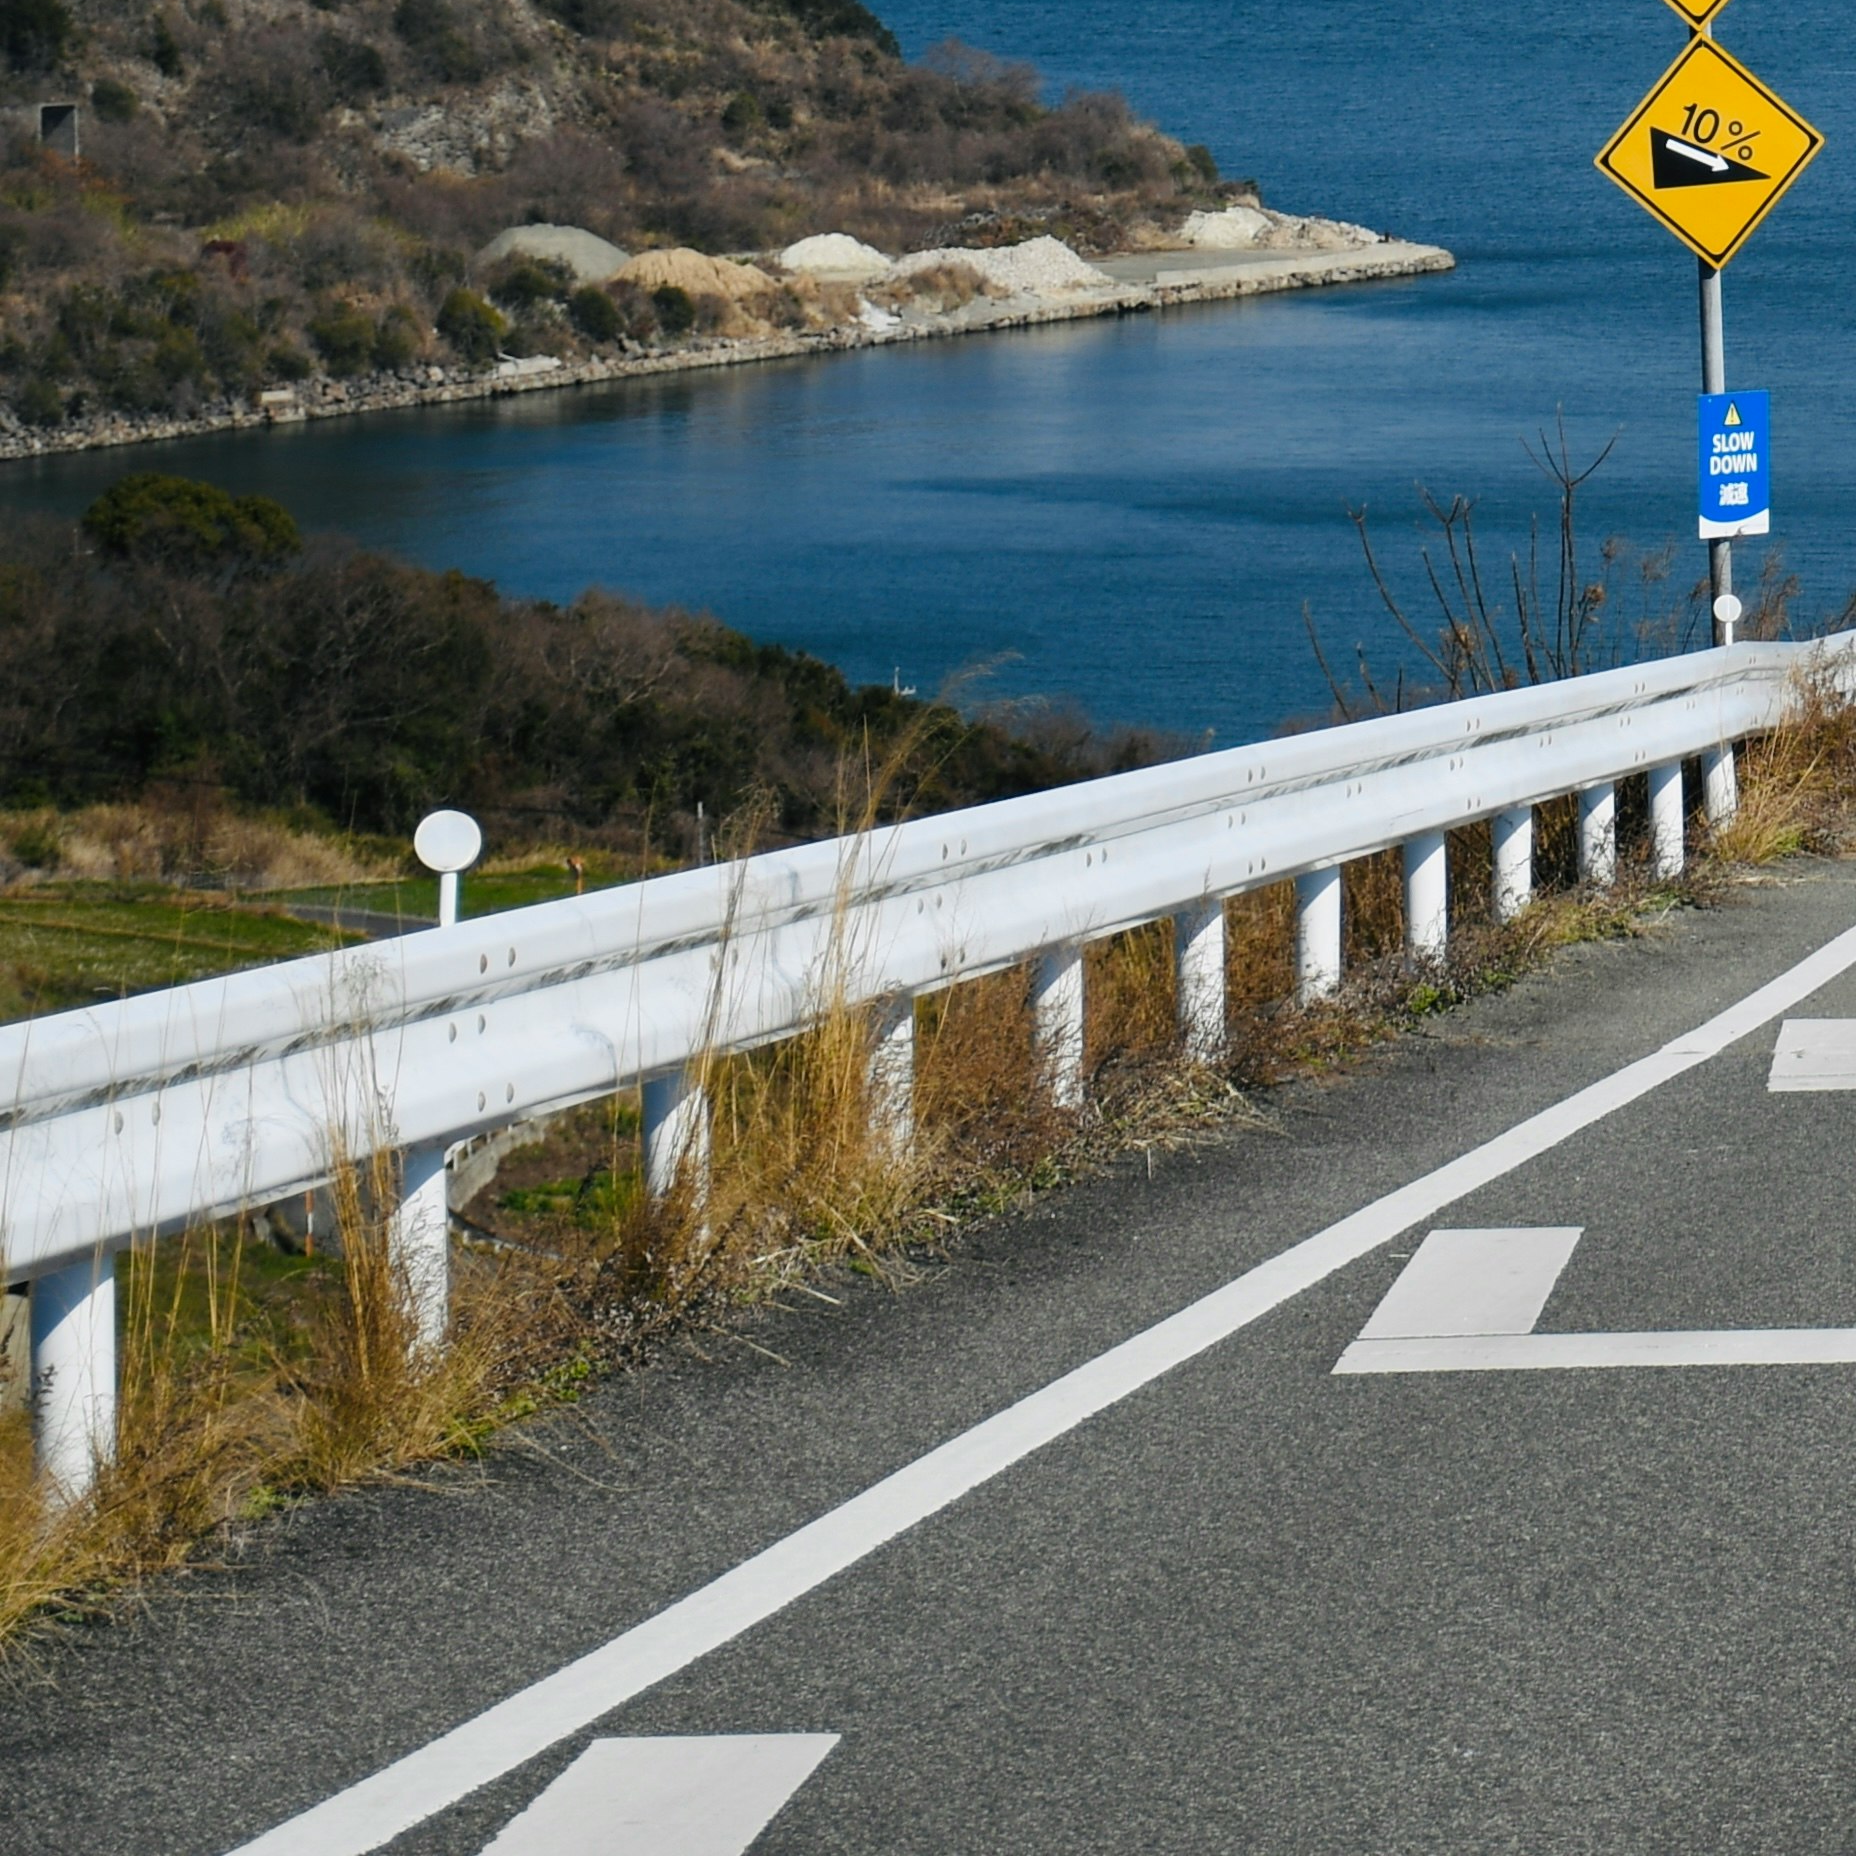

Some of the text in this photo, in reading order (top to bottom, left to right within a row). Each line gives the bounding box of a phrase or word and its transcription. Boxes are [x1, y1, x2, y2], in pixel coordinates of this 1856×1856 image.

[1681, 103, 1761, 161] 10%
[1712, 431, 1755, 453] SLOW
[1710, 453, 1758, 475] DOWN
